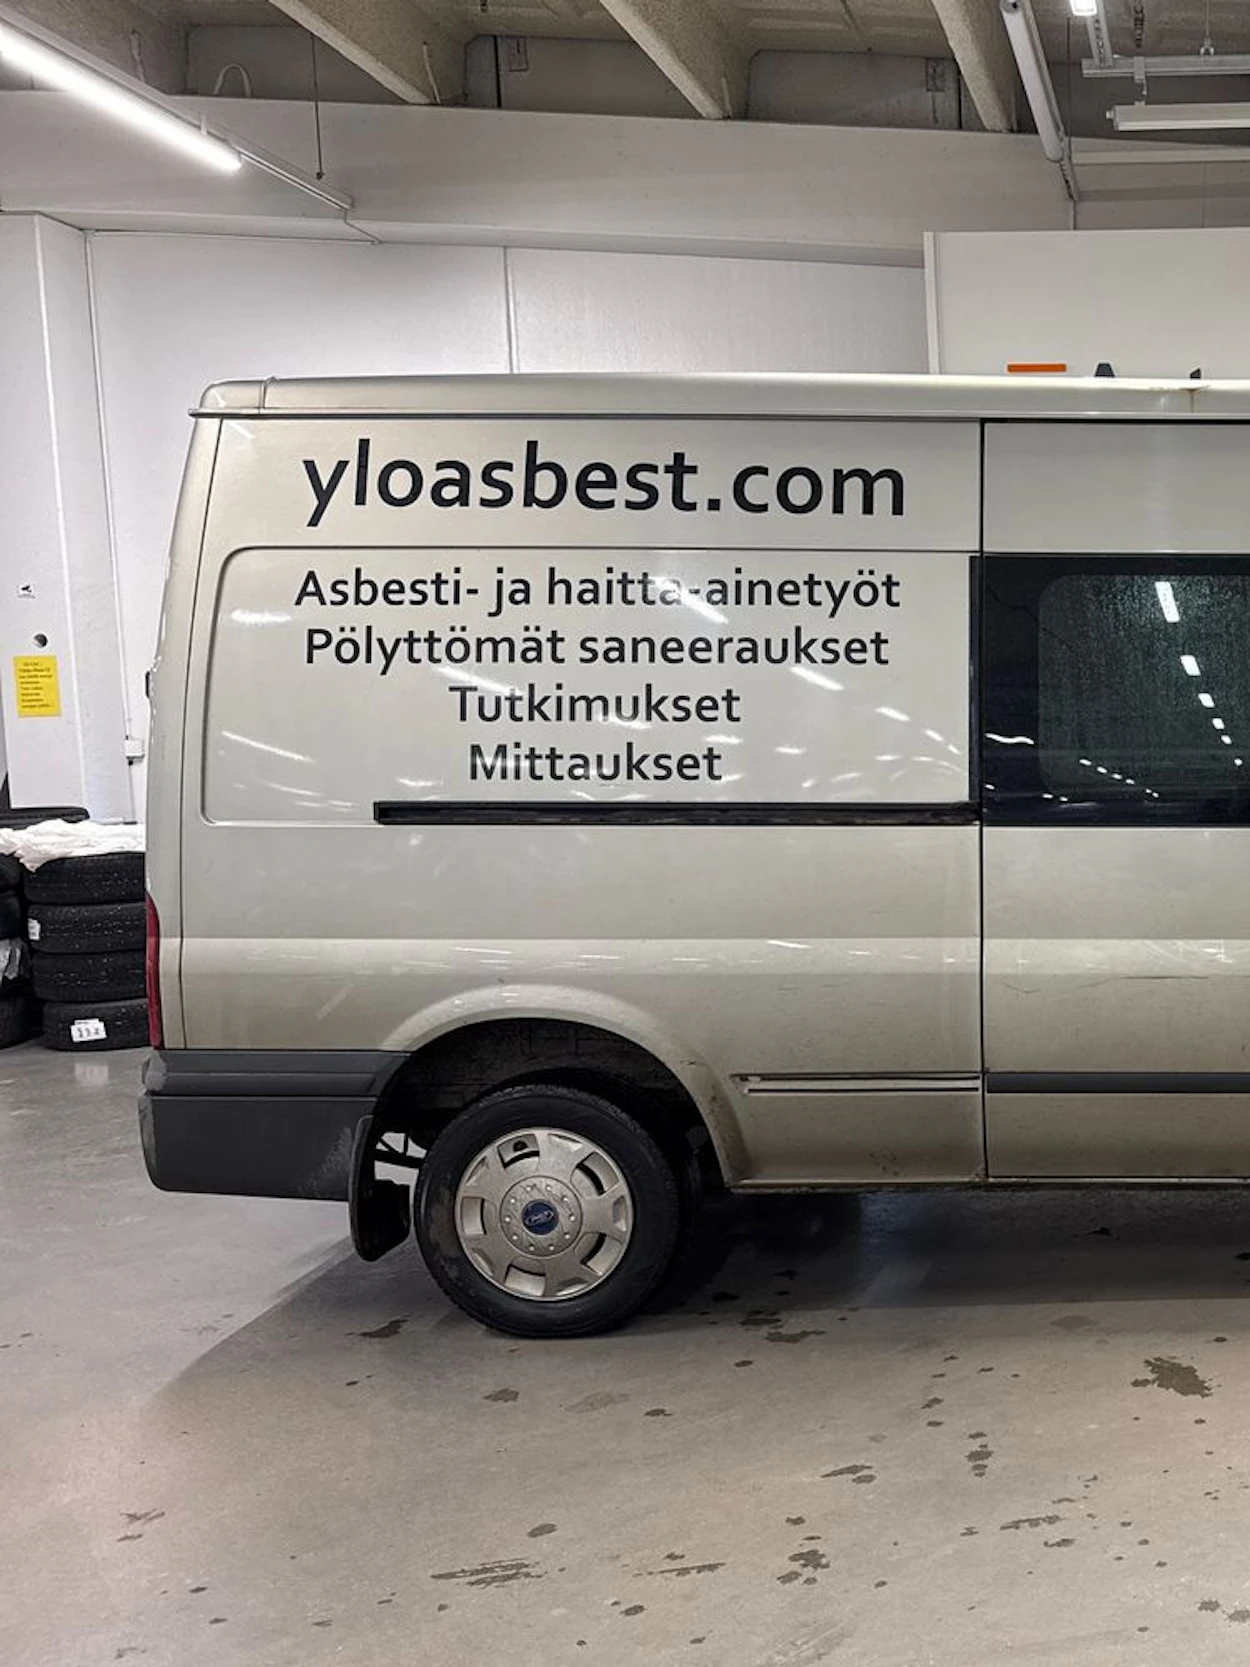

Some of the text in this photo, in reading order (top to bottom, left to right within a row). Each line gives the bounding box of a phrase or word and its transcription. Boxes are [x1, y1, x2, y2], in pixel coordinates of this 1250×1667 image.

[302, 438, 904, 527] yloasbest.com
[294, 566, 901, 619] Asbesti- ja haitta-ainetyöt
[306, 625, 890, 676] Pölyttömät saneeraukset
[448, 682, 741, 724] Tutkimukset
[469, 741, 723, 782] Mittaukset
